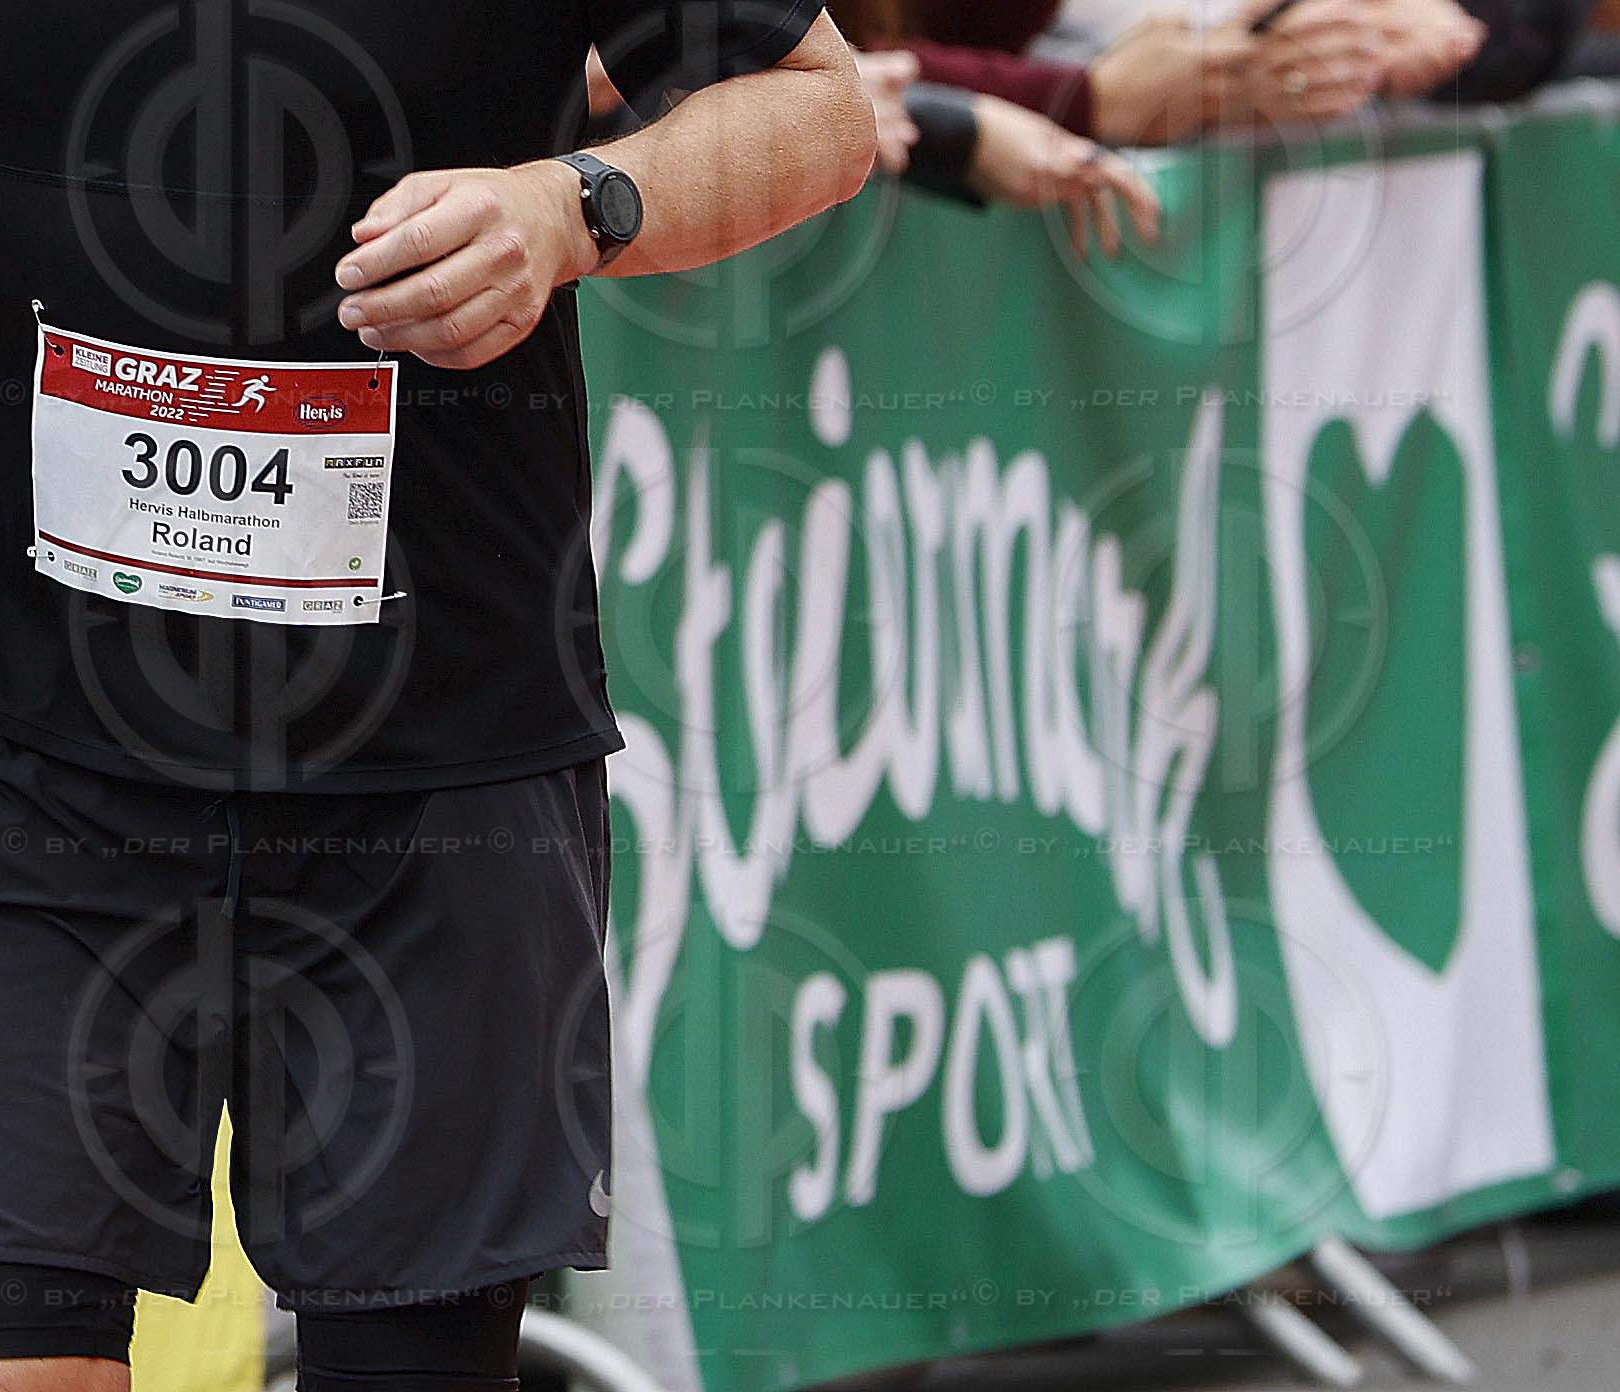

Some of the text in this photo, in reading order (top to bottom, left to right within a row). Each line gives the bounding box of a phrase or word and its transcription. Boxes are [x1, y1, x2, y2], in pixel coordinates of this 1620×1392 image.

[74, 359, 109, 375] ZEITUNG
[75, 348, 110, 365] KLEINE
[115, 357, 203, 392] GRAZ
[94, 378, 174, 405] MARATHON
[149, 404, 185, 420] 2022
[299, 403, 343, 423] Hervis
[121, 432, 294, 505] 3004
[129, 497, 281, 529] Hervis Halbmarathon
[151, 521, 253, 556] Roland
